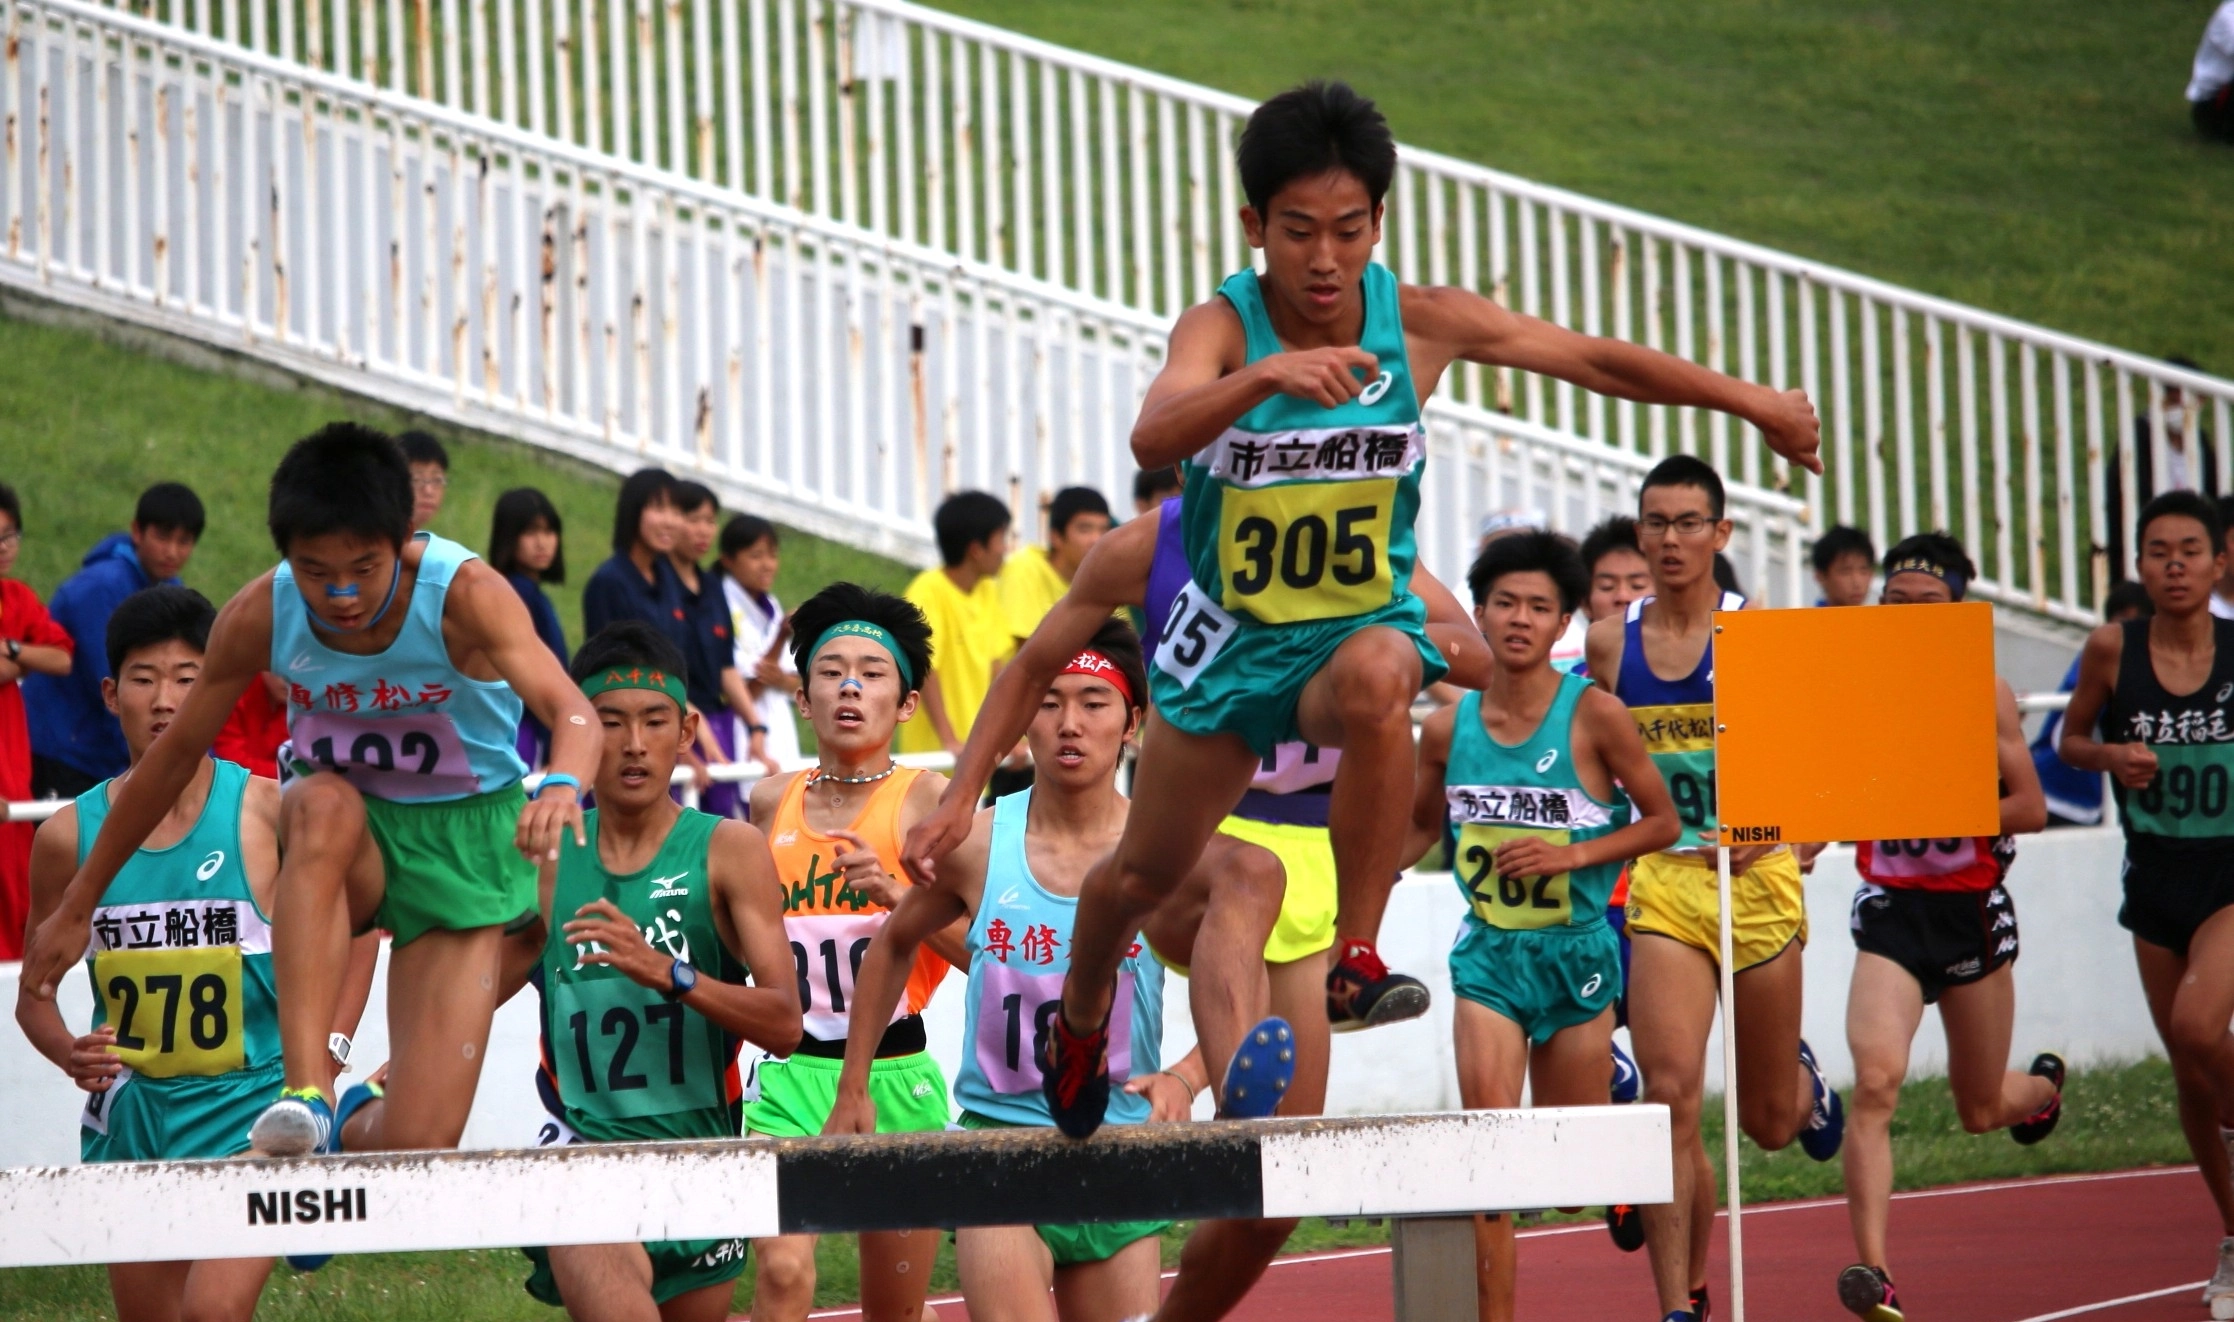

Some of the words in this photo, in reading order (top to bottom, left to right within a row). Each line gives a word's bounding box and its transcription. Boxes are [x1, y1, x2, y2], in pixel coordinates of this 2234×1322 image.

[1228, 431, 1410, 481] 市立船橋
[1231, 505, 1379, 596] 305
[604, 666, 666, 688] 八千代
[1638, 715, 1715, 743] 八千代松
[2129, 708, 2234, 744] 市立稲毛
[1458, 791, 1570, 824] 市立船橋
[1732, 825, 1781, 843] NISHI
[93, 906, 238, 951] 市立船橋
[571, 908, 690, 971] 八代
[108, 973, 228, 1054] 278
[569, 1003, 685, 1094] 127
[247, 1187, 367, 1226] NISHI
